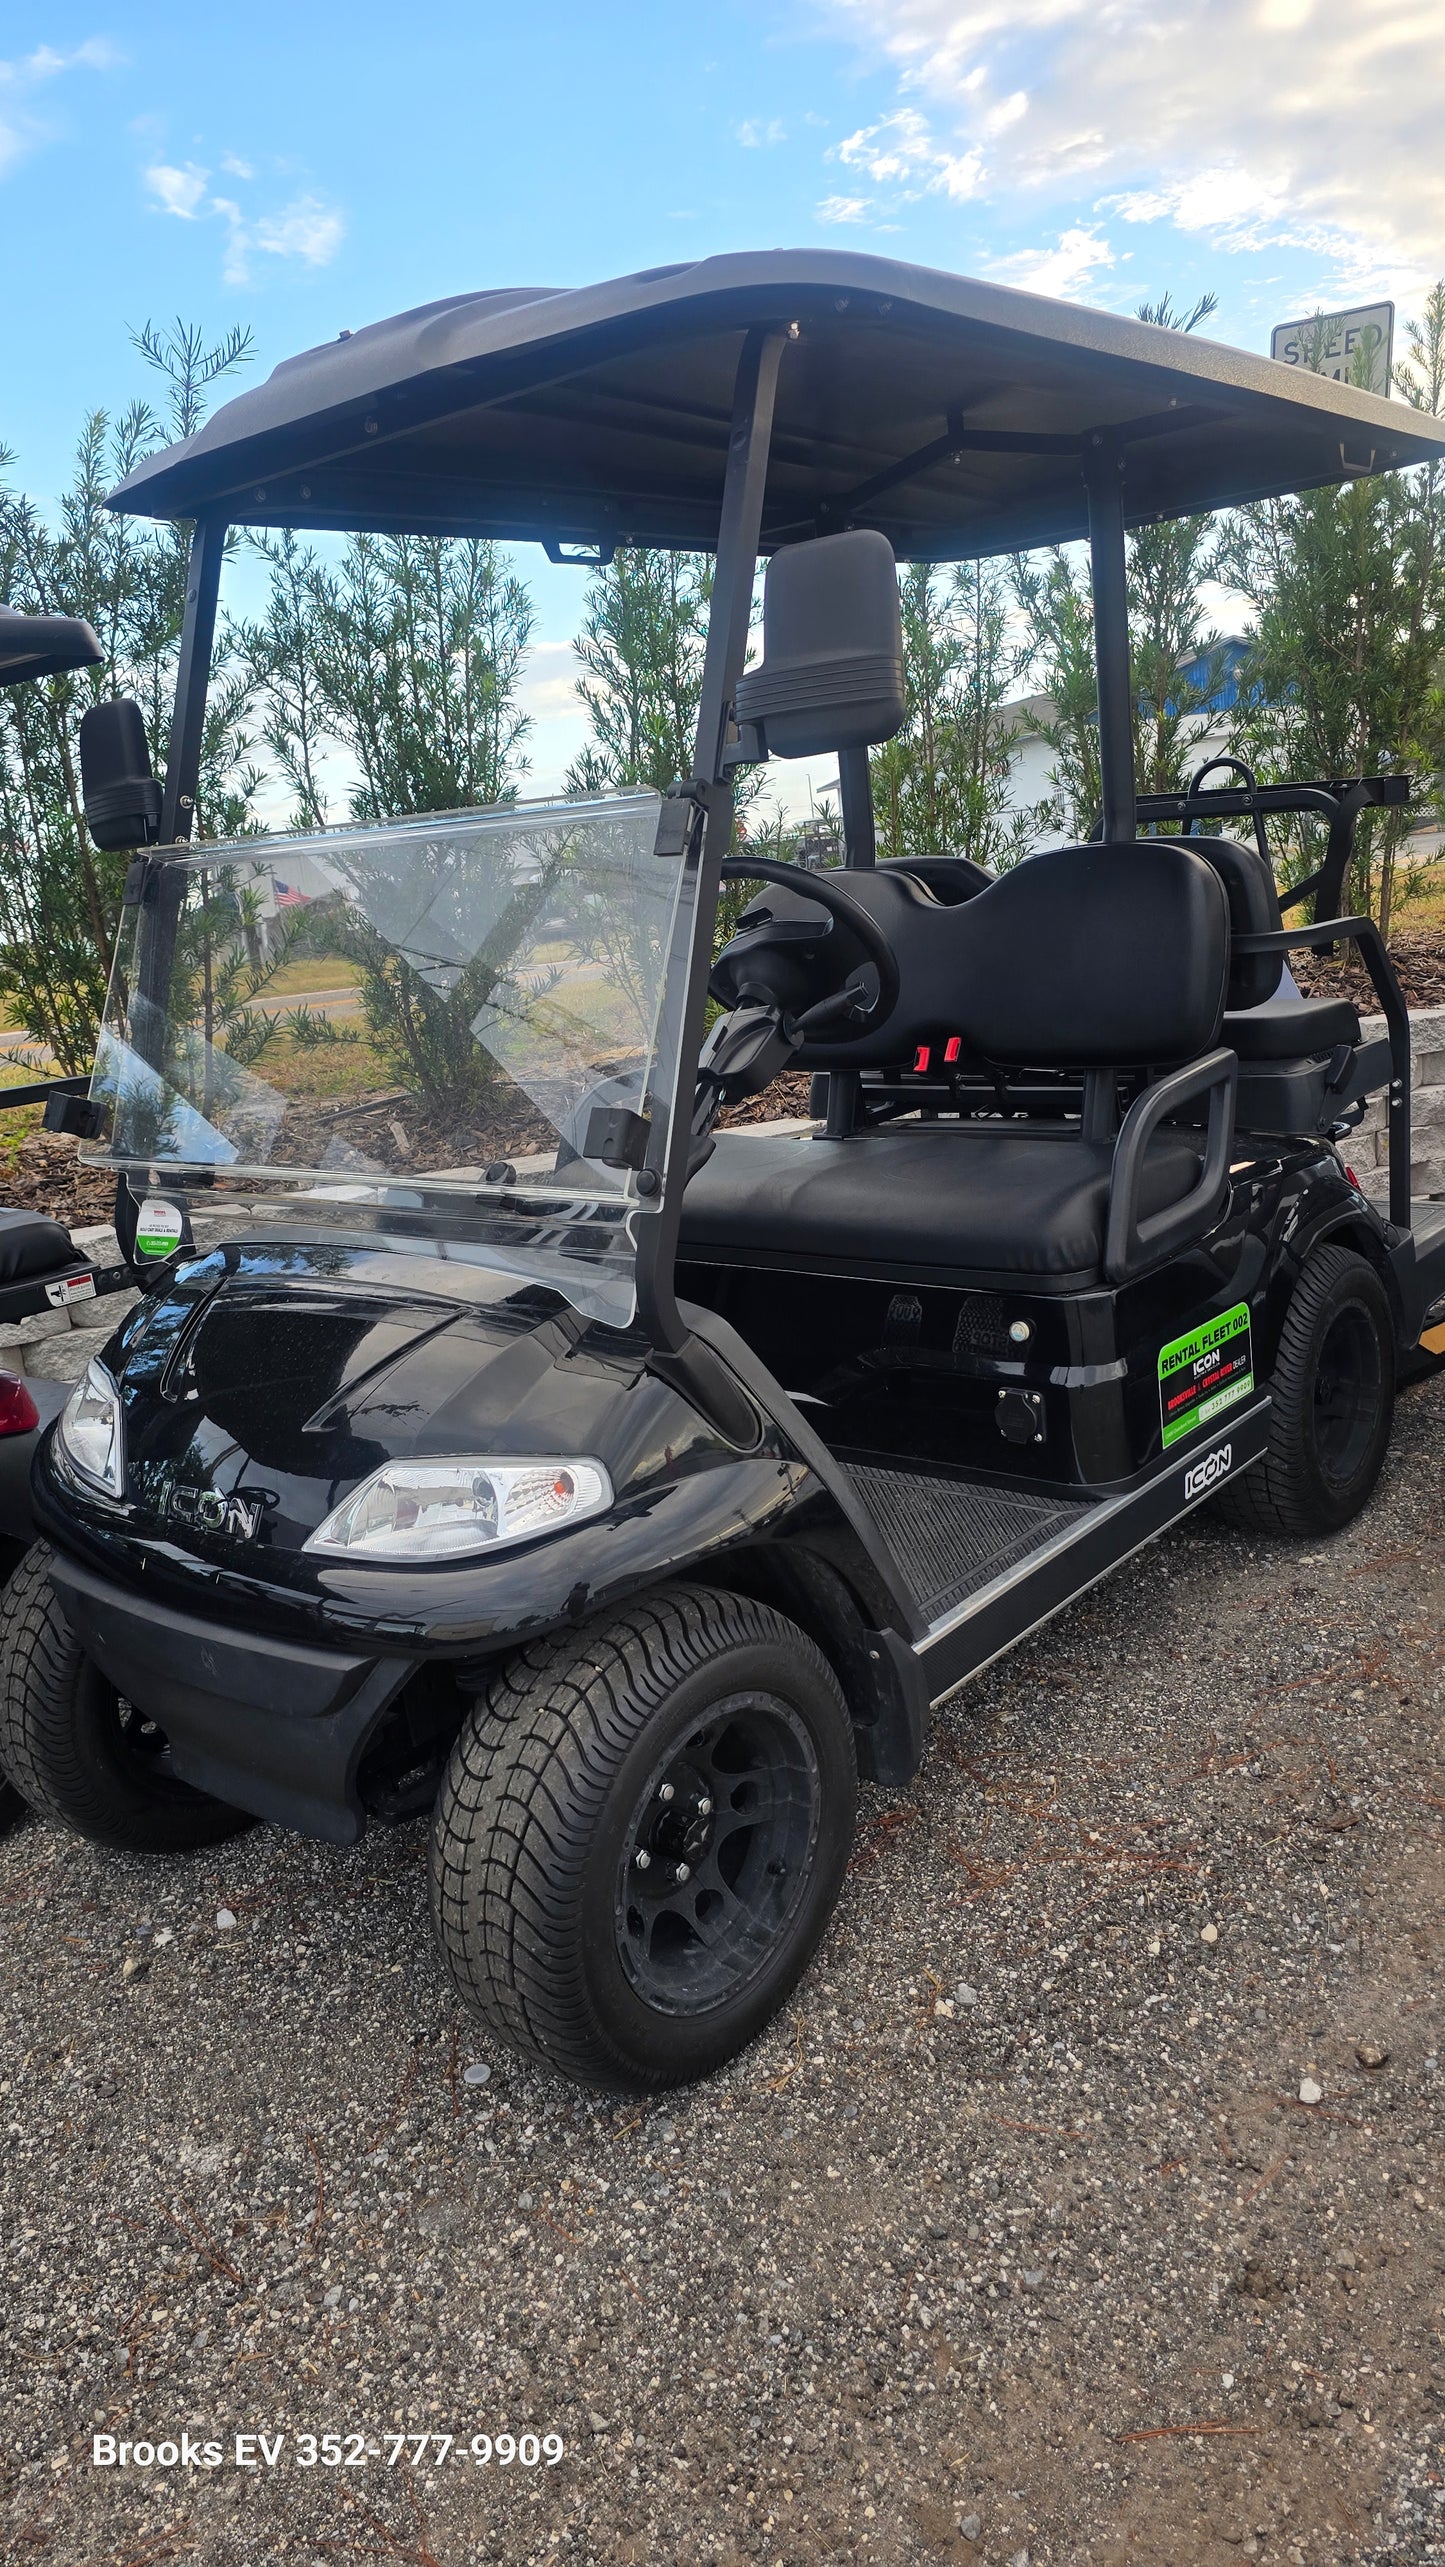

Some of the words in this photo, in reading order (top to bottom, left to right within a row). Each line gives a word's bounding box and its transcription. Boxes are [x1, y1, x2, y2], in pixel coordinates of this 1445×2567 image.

[1162, 1341, 1200, 1374] RENTAL
[1202, 1322, 1231, 1350] FLEET
[1233, 1313, 1248, 1331] 002
[1193, 1349, 1220, 1376] ICON
[1233, 1355, 1246, 1370] DEALER
[1211, 1398, 1223, 1411] 352
[1185, 1443, 1231, 1499] ICON
[159, 1481, 264, 1538] ICON
